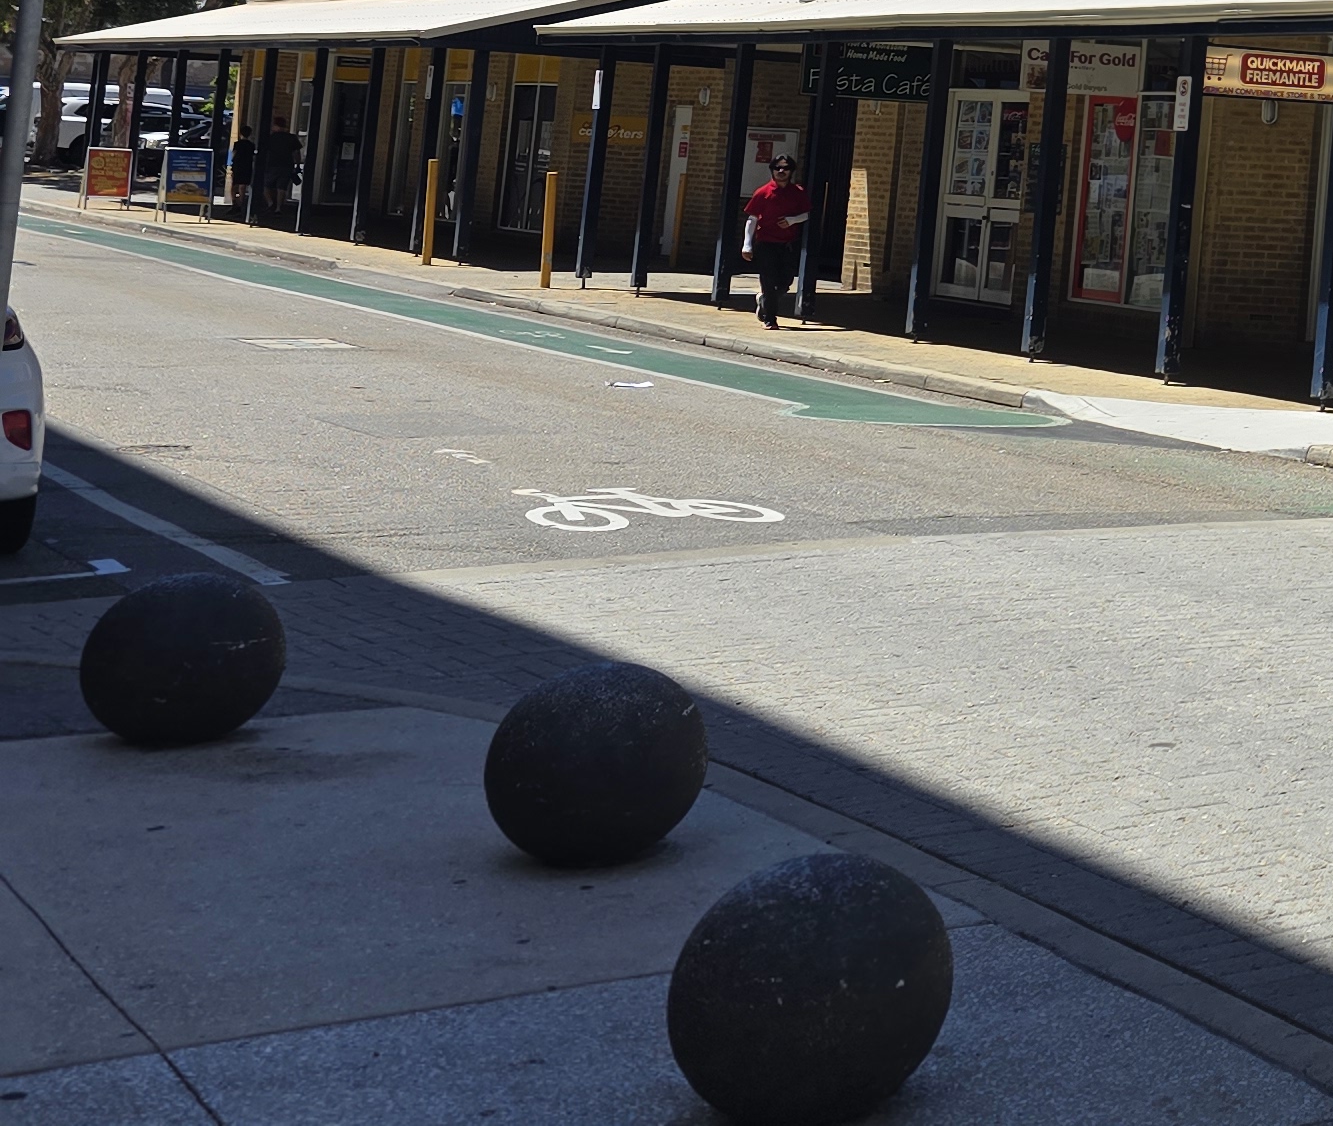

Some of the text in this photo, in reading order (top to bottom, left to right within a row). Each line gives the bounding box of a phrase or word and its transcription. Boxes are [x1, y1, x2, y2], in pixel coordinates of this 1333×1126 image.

[847, 49, 907, 63] Home Made Food
[1027, 47, 1136, 67] Ca For Gold
[1247, 57, 1321, 73] QUICKMART
[883, 74, 932, 96] Café
[1246, 71, 1319, 86] FREMANTLE
[1235, 88, 1284, 97] CONVENIENCE
[1286, 91, 1308, 99] STORE
